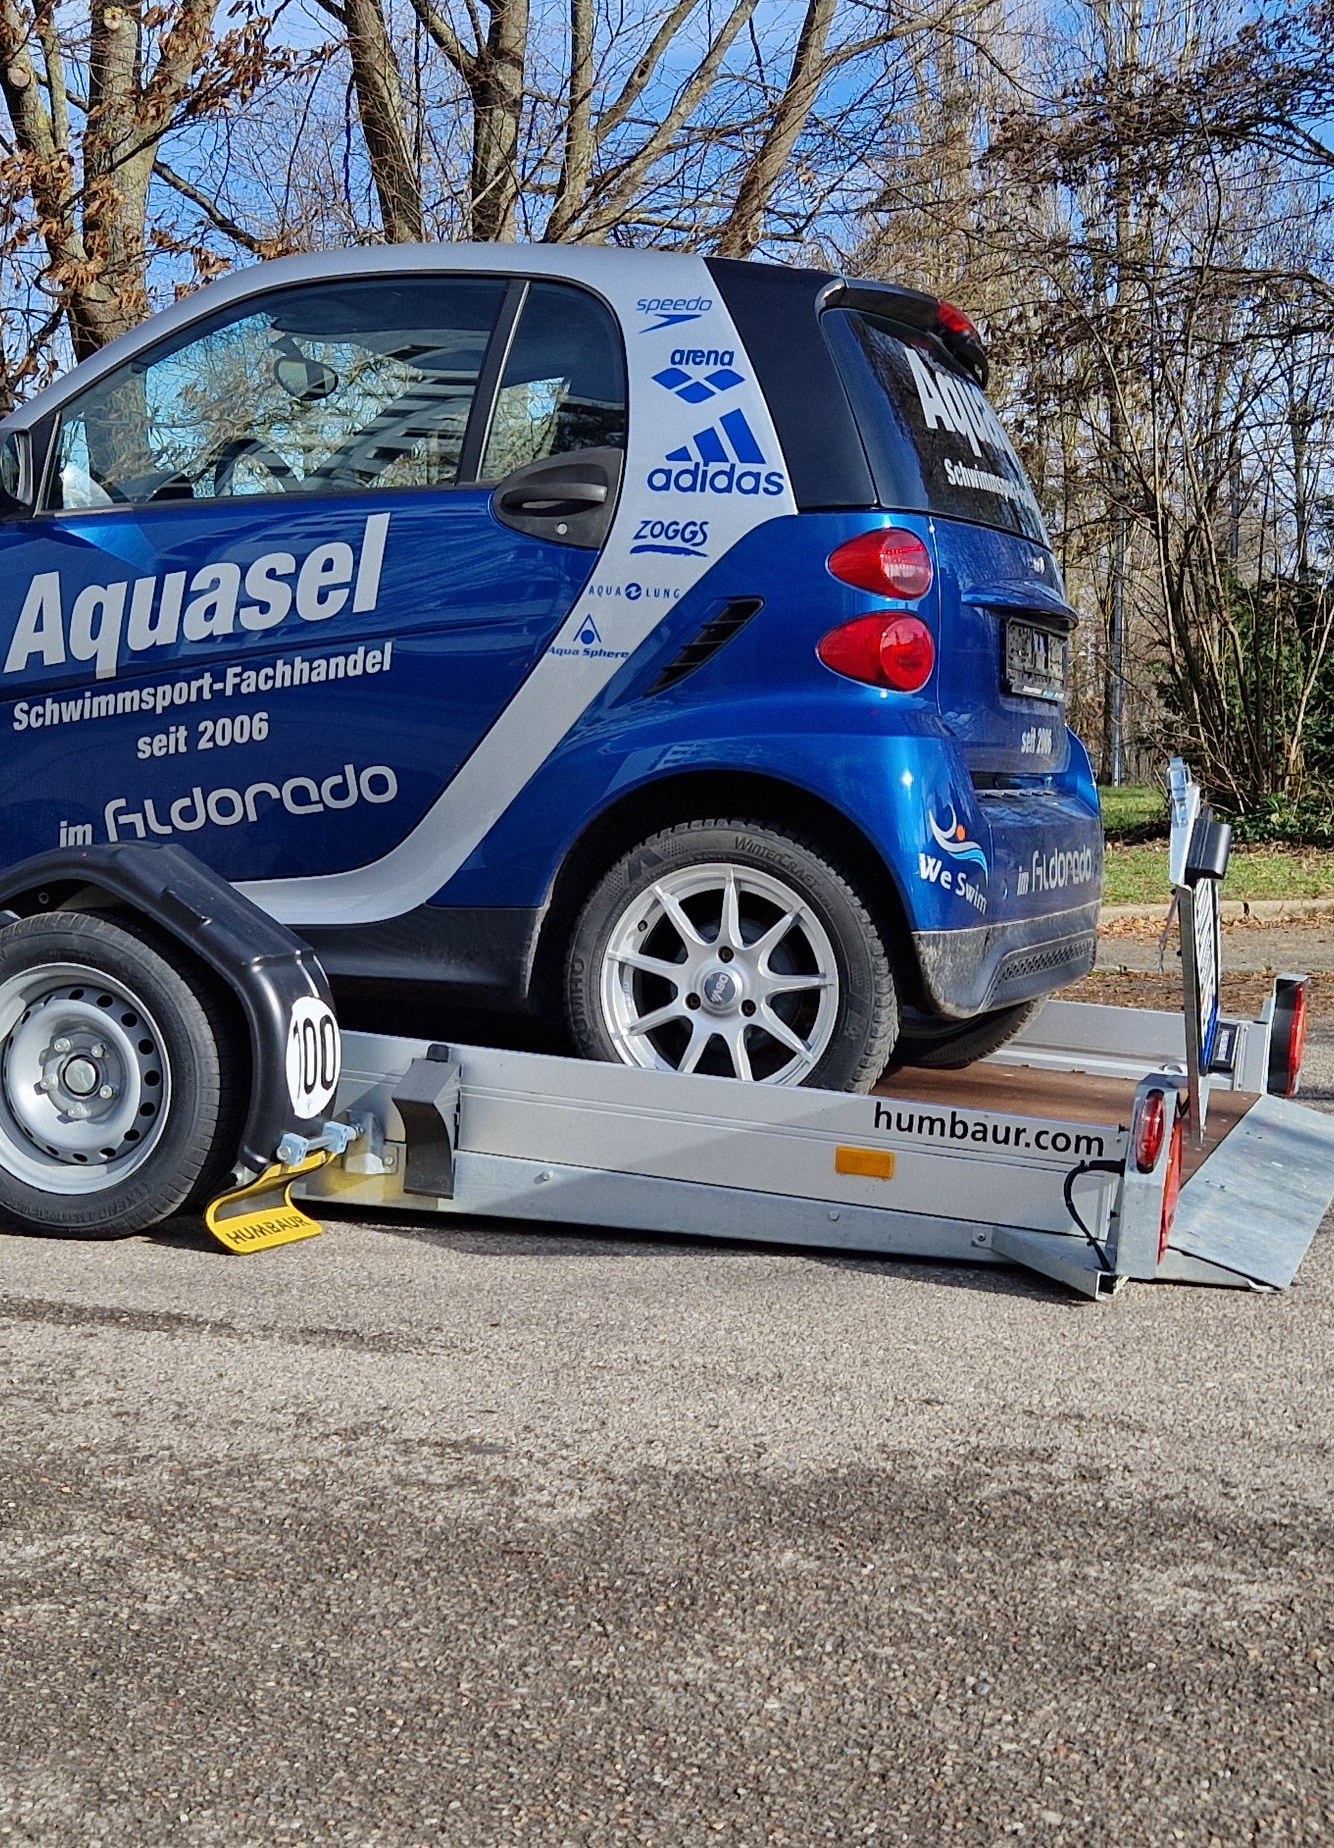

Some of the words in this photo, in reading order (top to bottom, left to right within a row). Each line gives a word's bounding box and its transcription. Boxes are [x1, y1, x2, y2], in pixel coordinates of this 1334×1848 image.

[636, 296, 713, 314] speedo
[670, 348, 734, 366] arena
[647, 462, 784, 495] adidas
[633, 520, 709, 546] ZOGGS
[3, 512, 391, 680] Aquasel
[588, 586, 621, 598] AQUA
[646, 587, 680, 599] LUNG
[548, 646, 579, 657] Aqua
[583, 647, 630, 659] Sphere
[12, 641, 393, 732] Schwimmsport-Fachhandel
[136, 725, 188, 761] seit
[197, 711, 270, 752] 2006
[59, 820, 94, 849] im
[919, 853, 952, 891] We
[955, 871, 988, 915] Swim
[1016, 865, 1031, 896] im
[293, 1014, 336, 1101] 100
[873, 1102, 1105, 1157] humbaur.com
[225, 1215, 310, 1245] HUMBAUR
